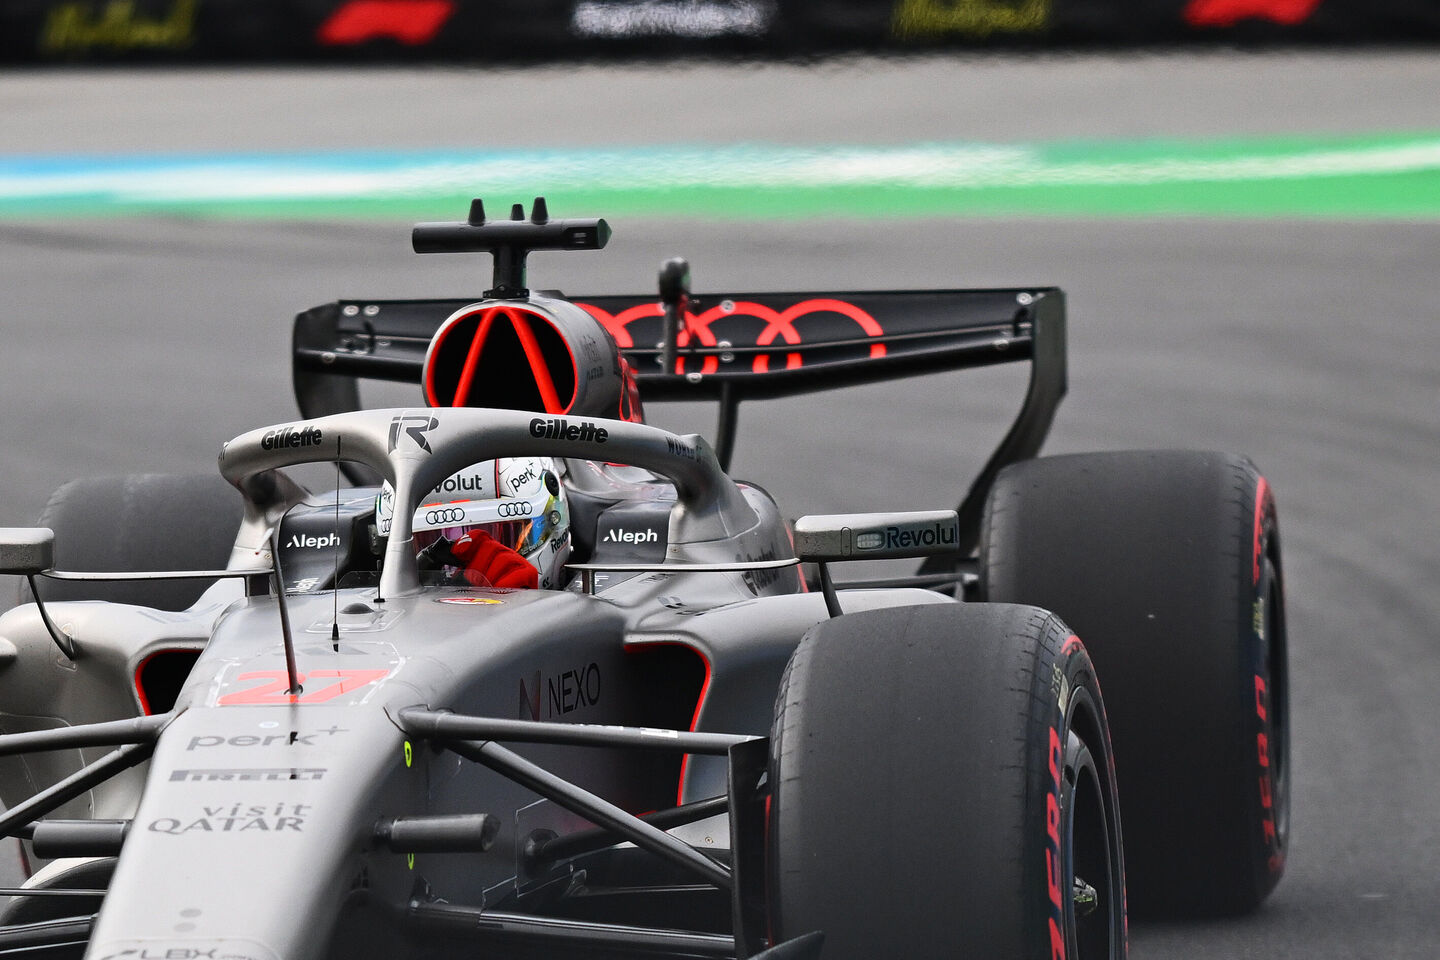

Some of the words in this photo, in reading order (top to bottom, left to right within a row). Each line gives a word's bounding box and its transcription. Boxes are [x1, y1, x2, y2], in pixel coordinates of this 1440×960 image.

[261, 425, 322, 450] Gillette
[529, 418, 609, 444] Gillette
[434, 474, 483, 493] volut
[286, 533, 341, 549] Aleph
[603, 528, 658, 545] Aleph
[886, 522, 958, 549] Revolu
[216, 669, 391, 705] 27
[548, 662, 601, 719] NEXO
[168, 768, 328, 782] PIRELLI
[202, 802, 312, 817] visit
[147, 817, 305, 836] QATAR
